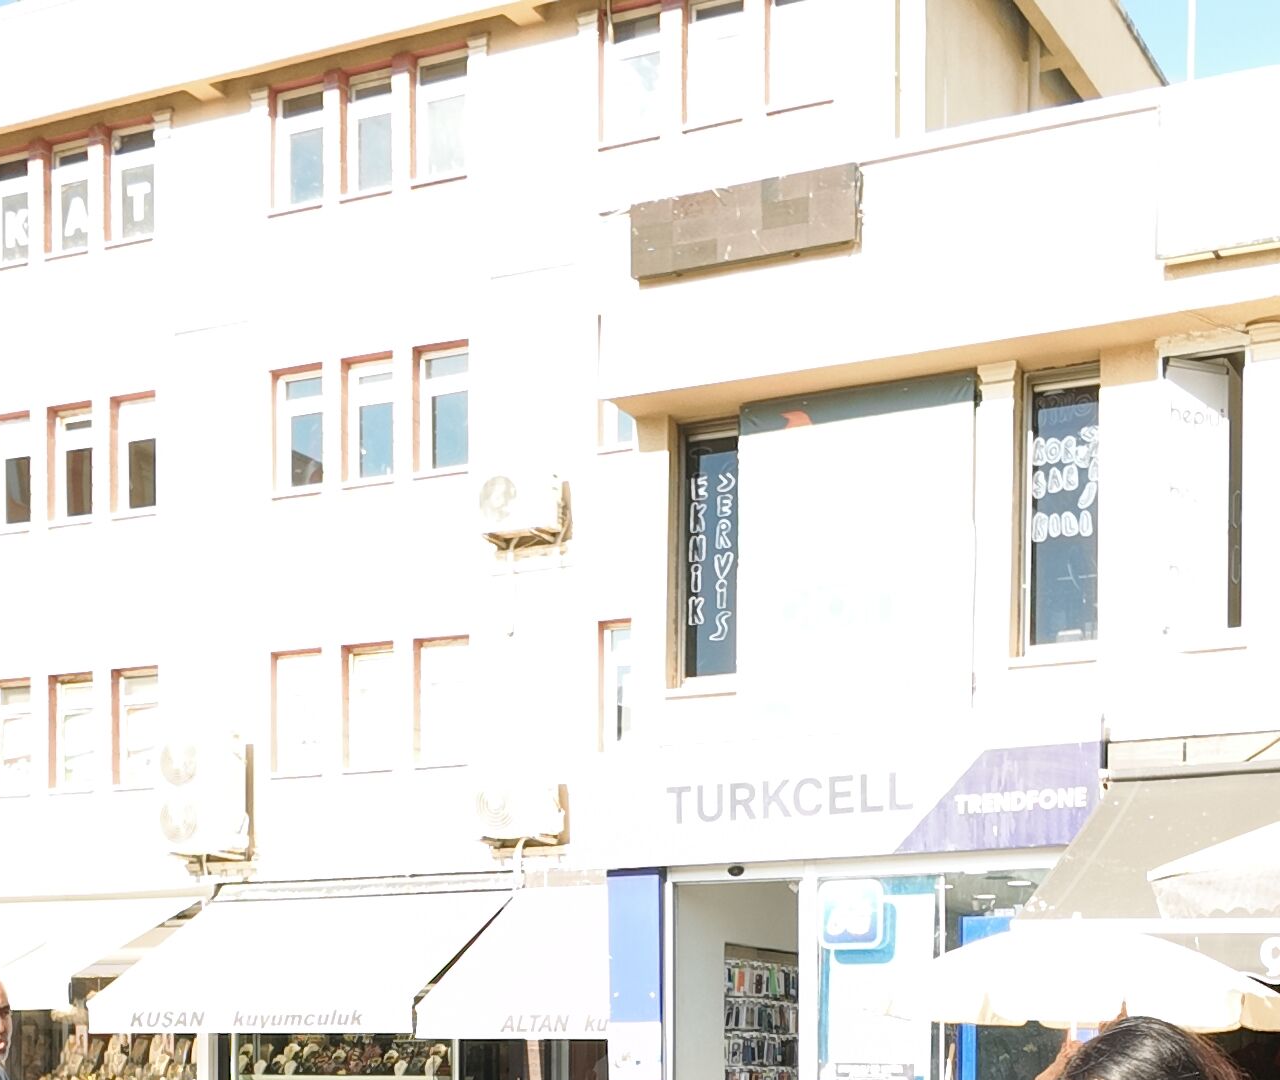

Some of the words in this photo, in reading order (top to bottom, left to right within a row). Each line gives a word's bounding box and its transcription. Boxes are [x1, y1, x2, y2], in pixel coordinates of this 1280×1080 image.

[666, 773, 914, 825] TURKCELL
[953, 786, 1088, 815] TRENDFONE
[232, 1009, 363, 1029] kuyumculuk
[500, 1014, 570, 1033] ALTAN
